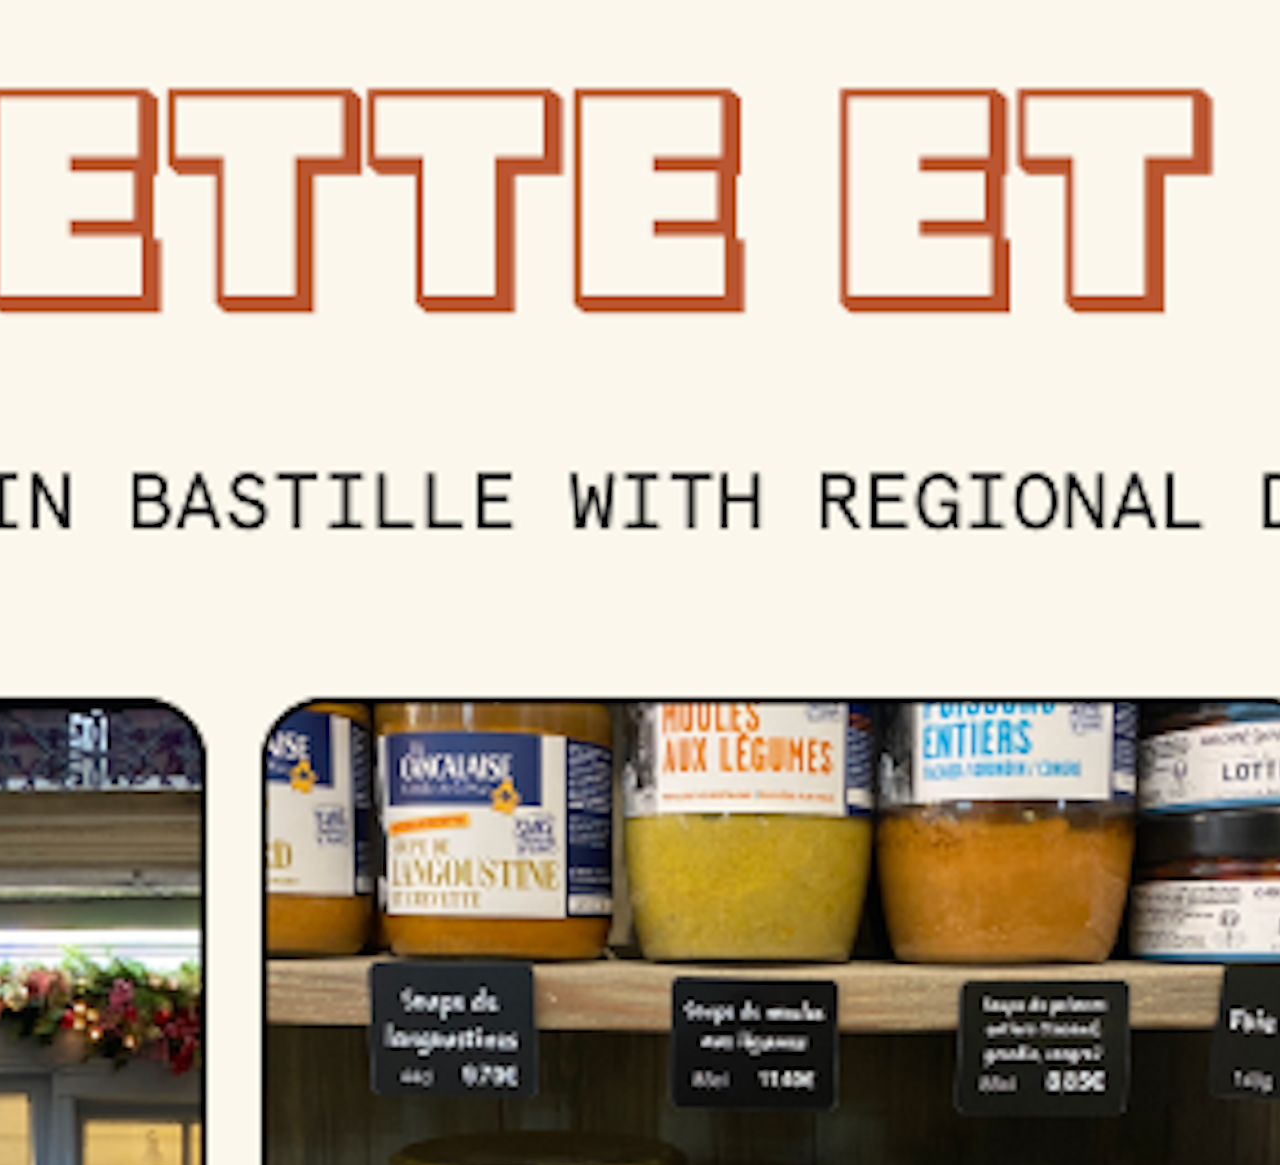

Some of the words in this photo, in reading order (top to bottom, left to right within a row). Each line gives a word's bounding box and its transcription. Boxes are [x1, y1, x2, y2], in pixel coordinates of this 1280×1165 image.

[662, 737, 708, 773] AUX
[923, 720, 1033, 759] ENTIERS
[392, 859, 560, 892] LANGOUSTINE
